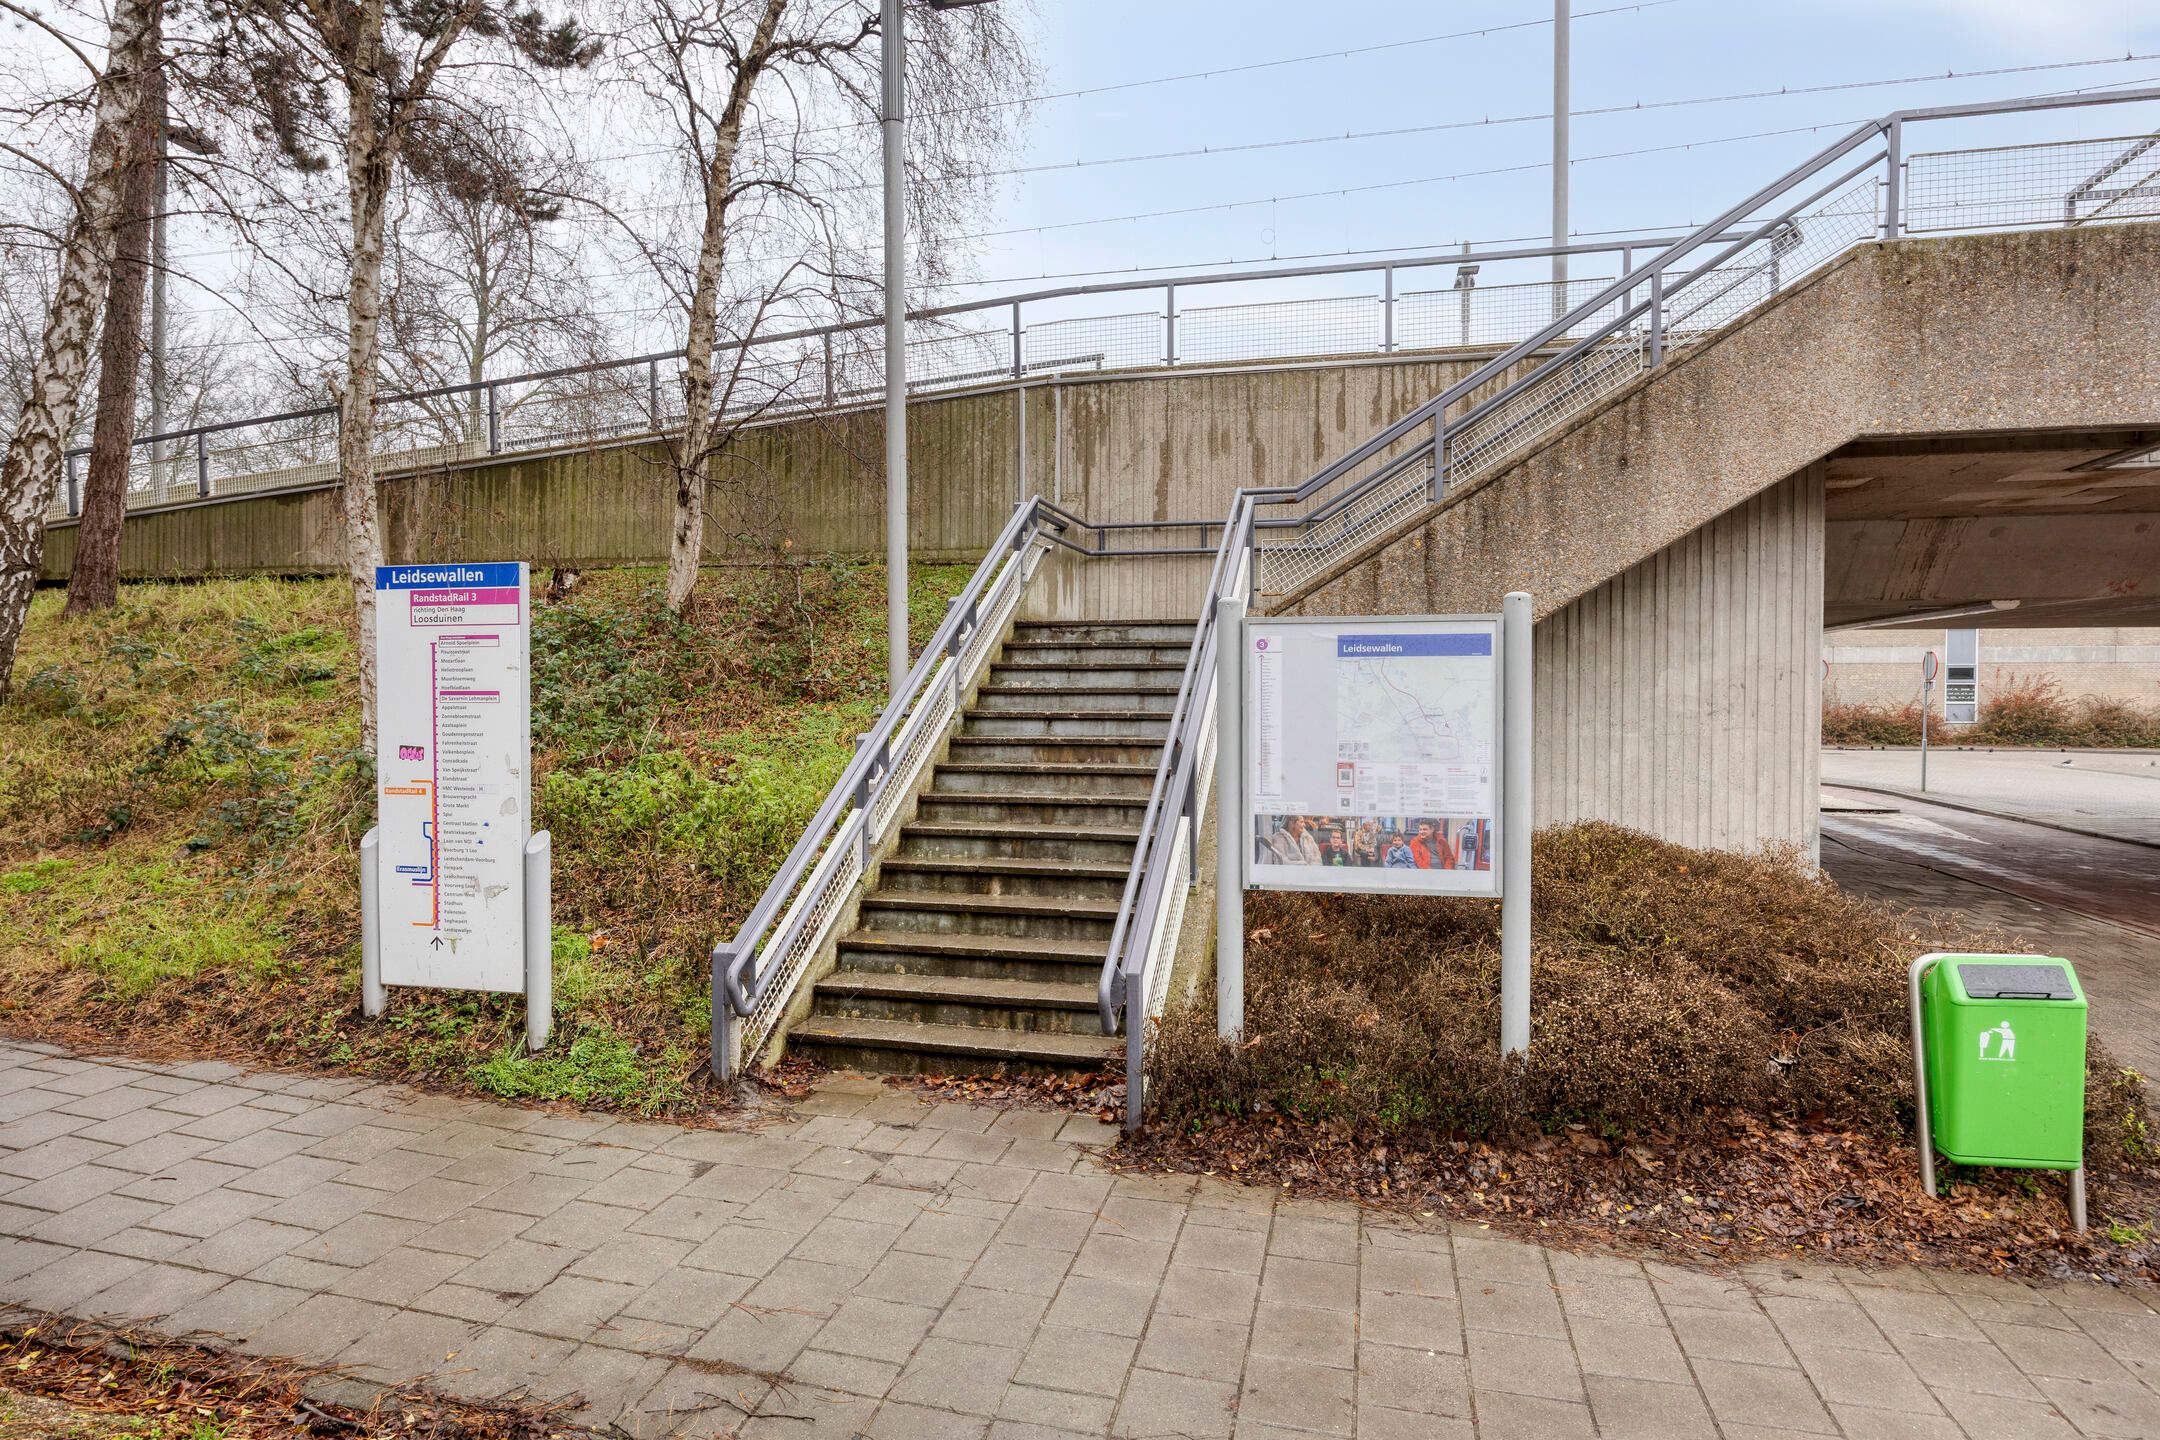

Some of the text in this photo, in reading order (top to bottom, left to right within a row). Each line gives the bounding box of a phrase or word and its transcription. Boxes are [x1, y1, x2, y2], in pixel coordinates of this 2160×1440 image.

[392, 568, 484, 584] Leidsewallen
[413, 593, 477, 602] RandstadRail 3
[413, 615, 463, 623] Loosduinen
[1343, 643, 1403, 653] Leidsewallen
